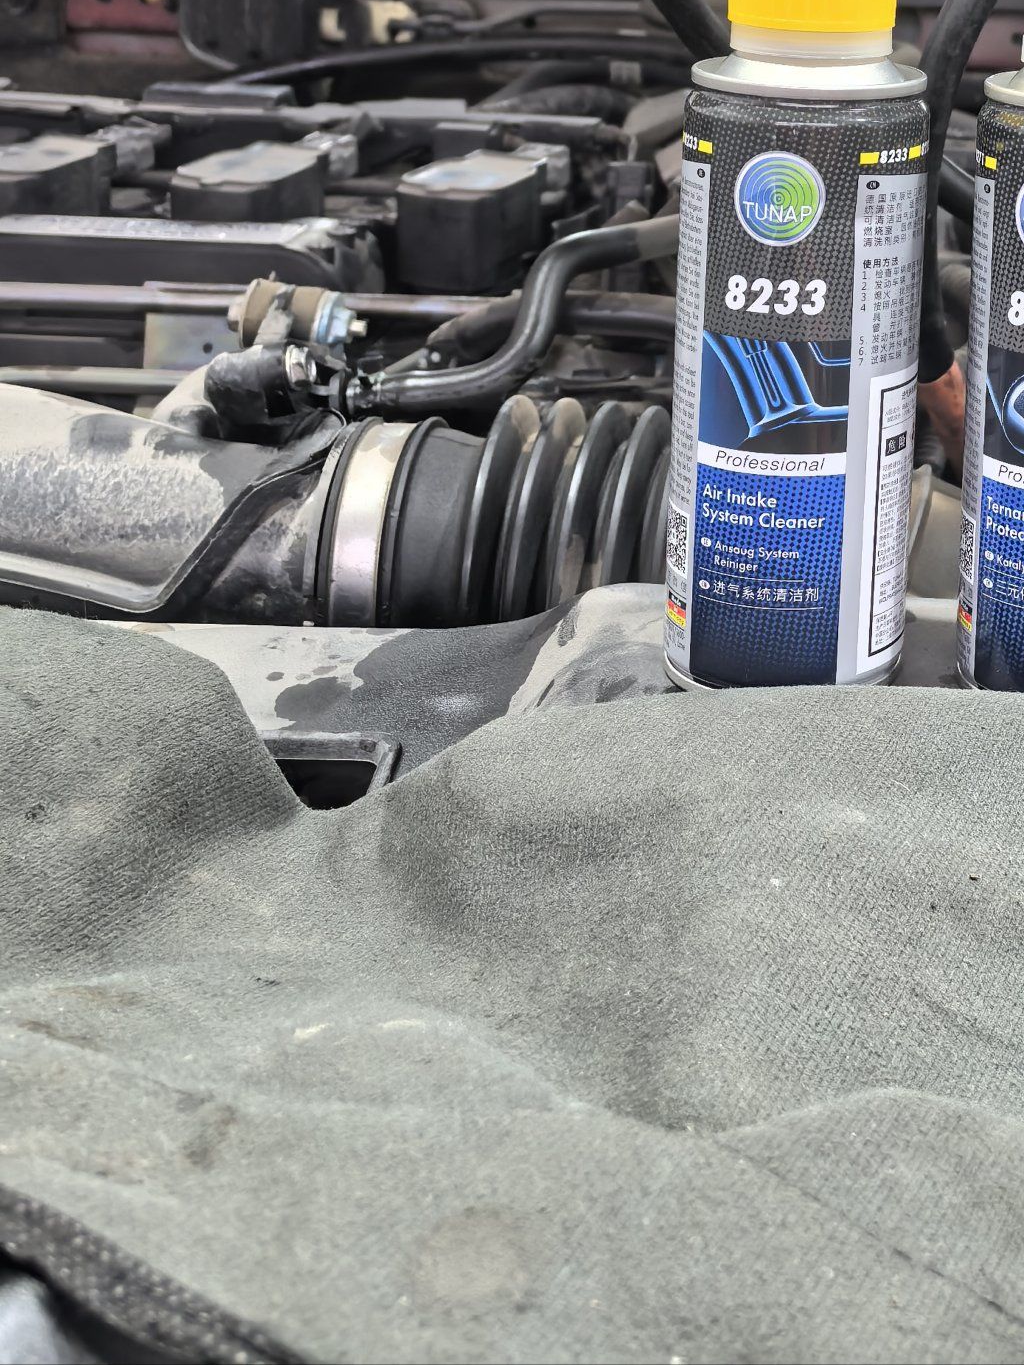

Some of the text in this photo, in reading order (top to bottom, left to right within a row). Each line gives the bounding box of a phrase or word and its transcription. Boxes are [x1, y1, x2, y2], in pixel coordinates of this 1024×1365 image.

[880, 148, 908, 164] 8233
[743, 201, 812, 224] TUNAP
[725, 274, 827, 316] 8233
[715, 450, 825, 472] Professional
[702, 483, 778, 509] Air Intake
[702, 503, 826, 529] System Cleaner
[714, 540, 755, 559] Ansaug
[758, 546, 800, 560] System
[713, 554, 758, 573] Reiniger
[713, 579, 820, 602] 进气系统清洁剂
